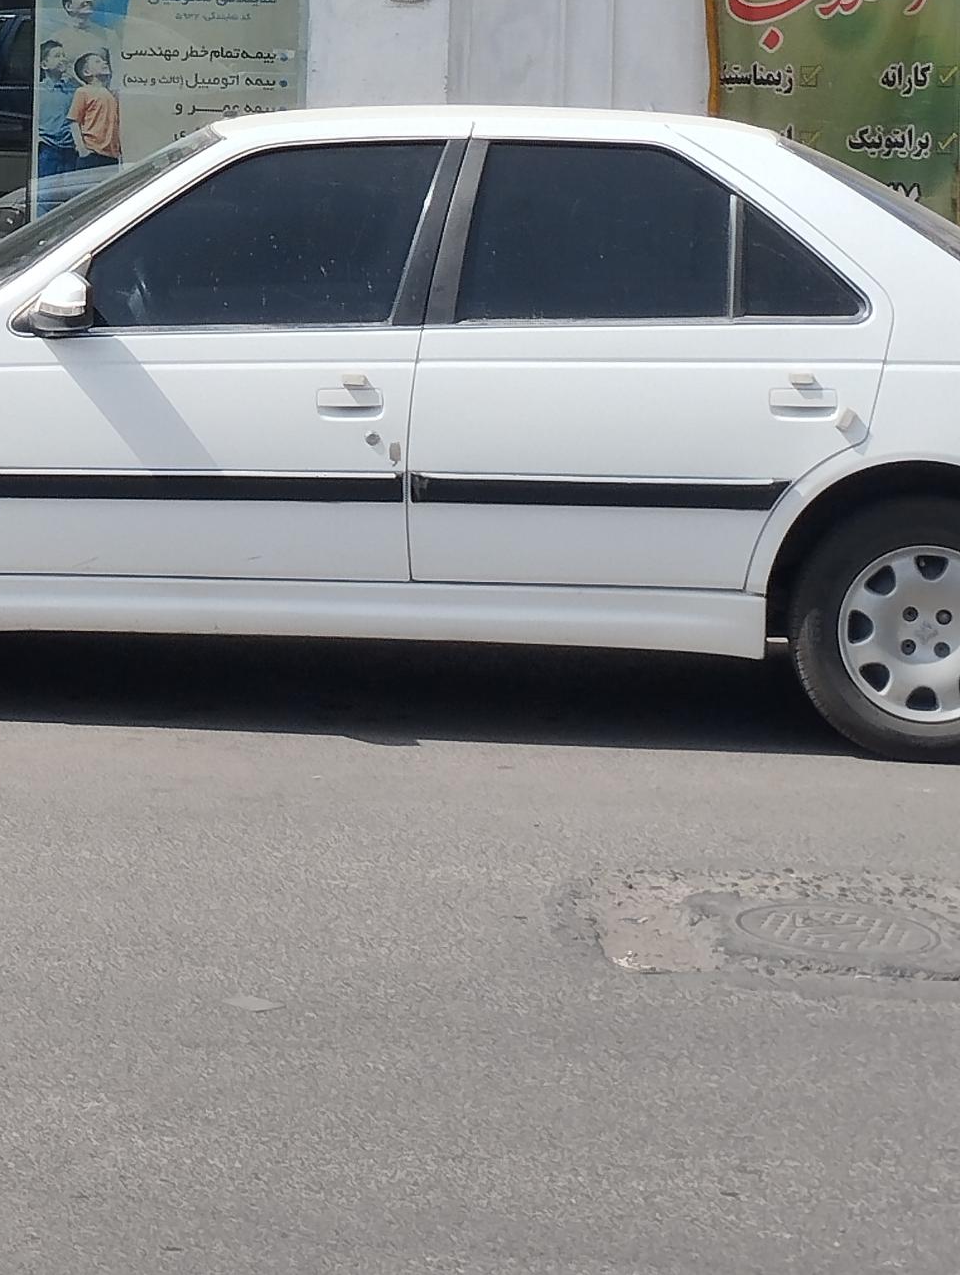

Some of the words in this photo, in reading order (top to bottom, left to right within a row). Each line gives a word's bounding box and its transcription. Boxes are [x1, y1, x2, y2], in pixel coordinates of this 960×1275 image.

[121, 47, 180, 61] مهندسی
[181, 46, 210, 61] خطر
[210, 46, 241, 62] تمام
[241, 50, 277, 64] بیمه
[185, 73, 240, 89] اتومبیل
[244, 75, 277, 91] بیمه
[879, 61, 933, 98] کاراته
